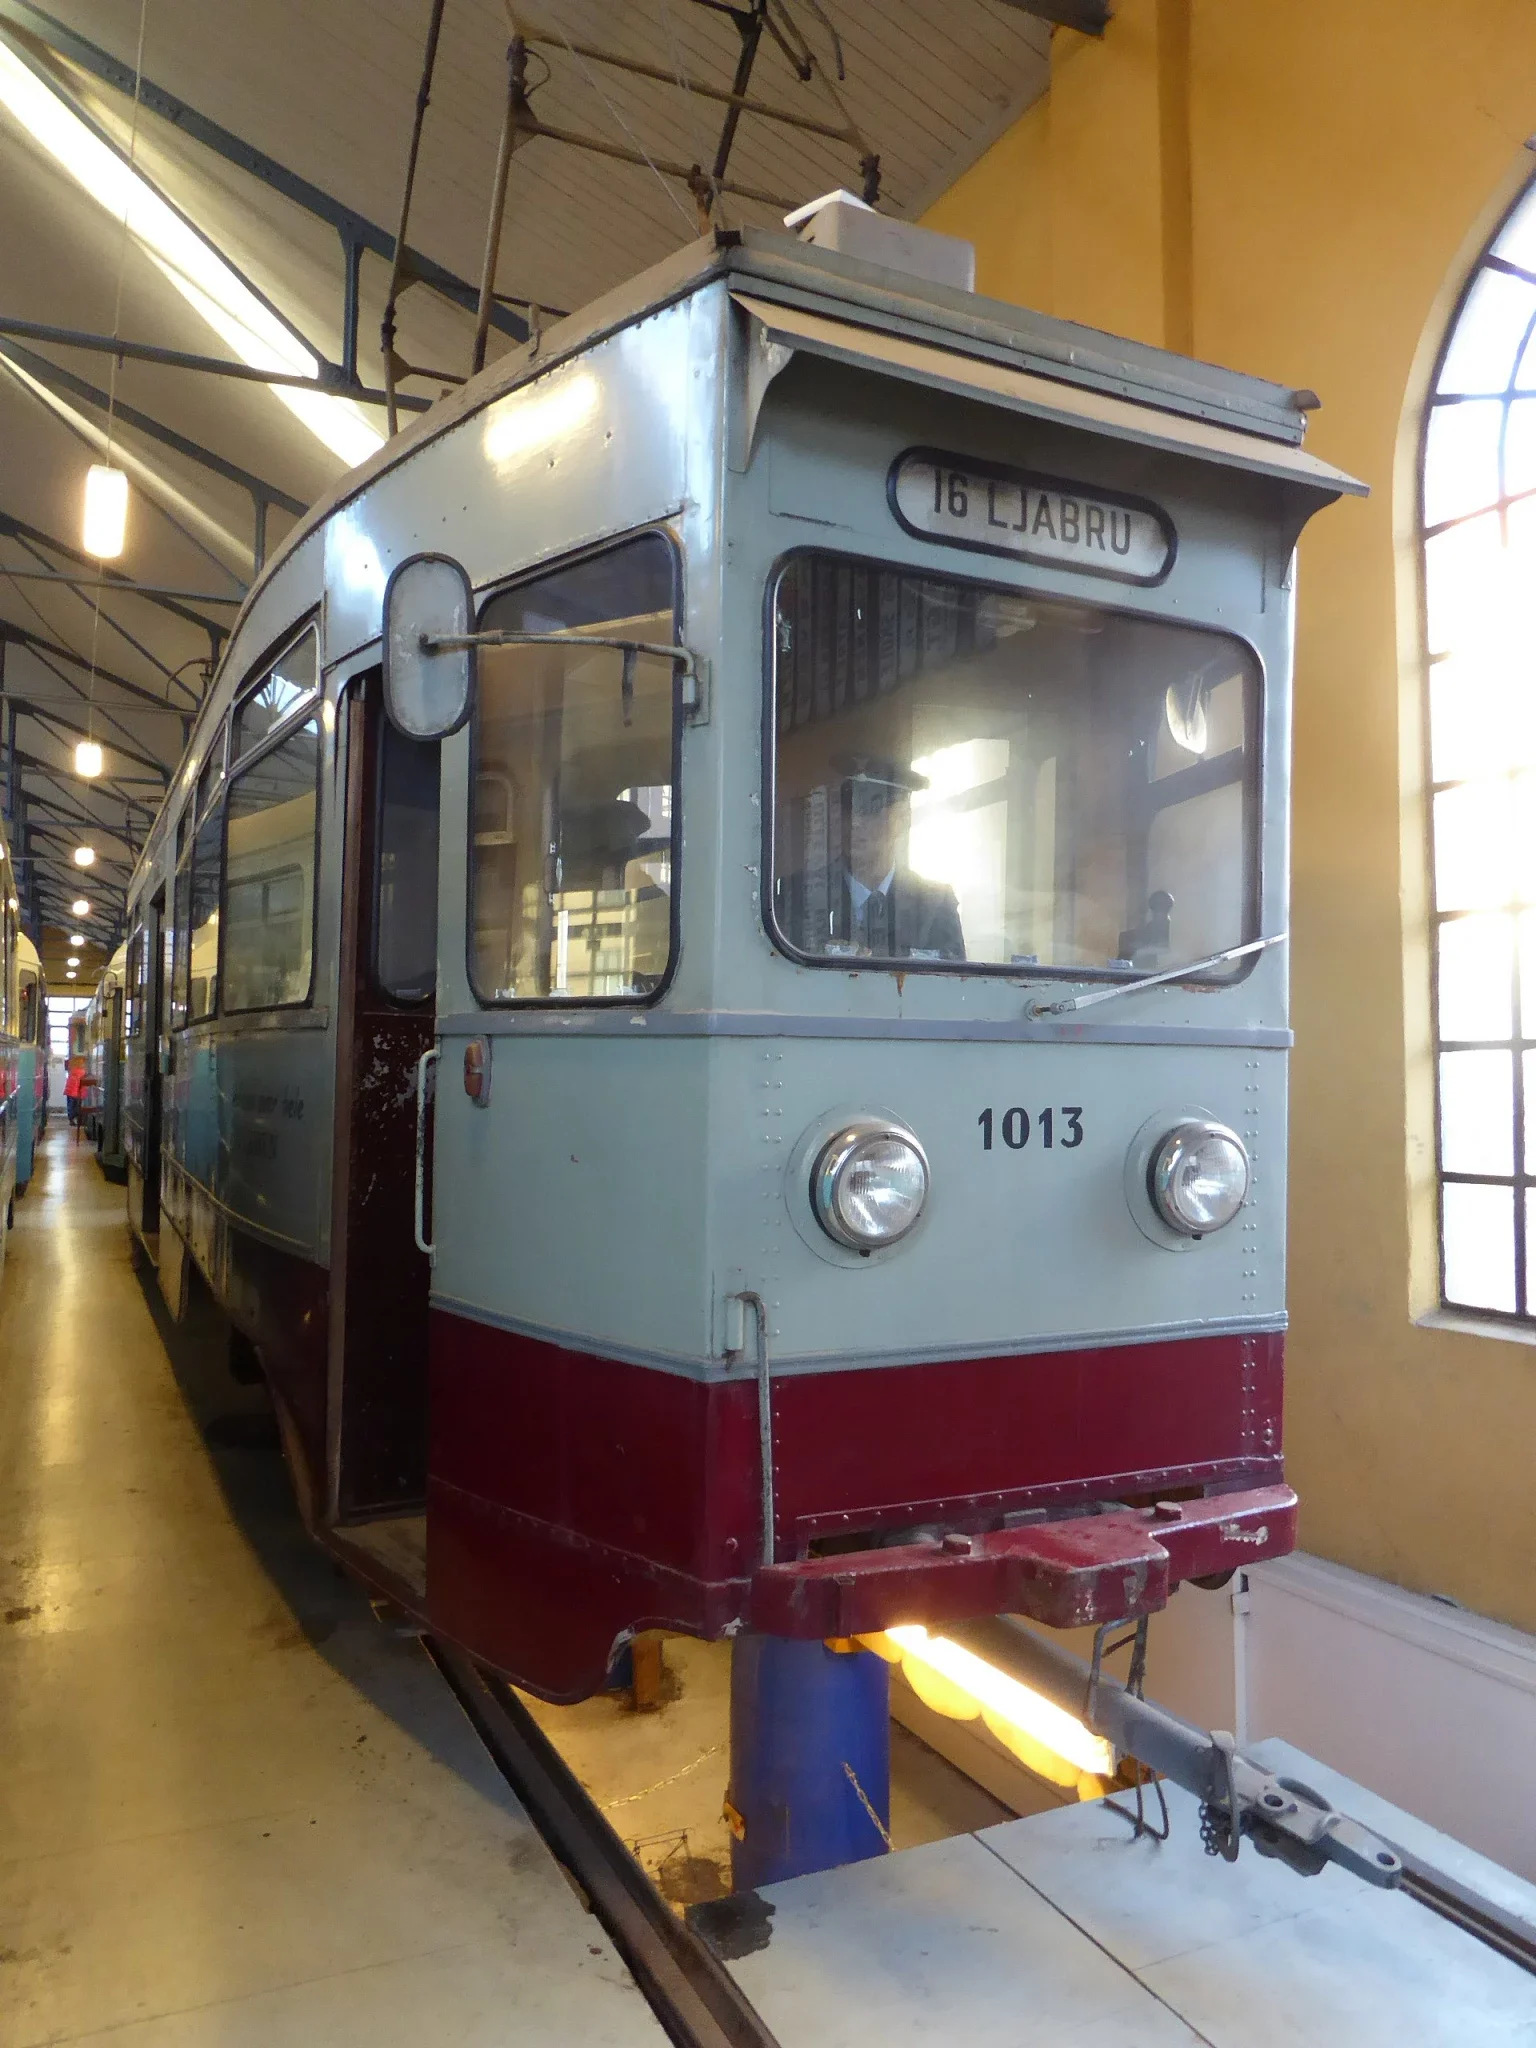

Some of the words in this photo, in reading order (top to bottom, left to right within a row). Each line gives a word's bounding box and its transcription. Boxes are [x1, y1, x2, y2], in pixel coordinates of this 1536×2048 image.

[933, 468, 968, 518] 16
[987, 481, 1131, 556] LJABRU
[978, 1106, 1084, 1150] 1013
